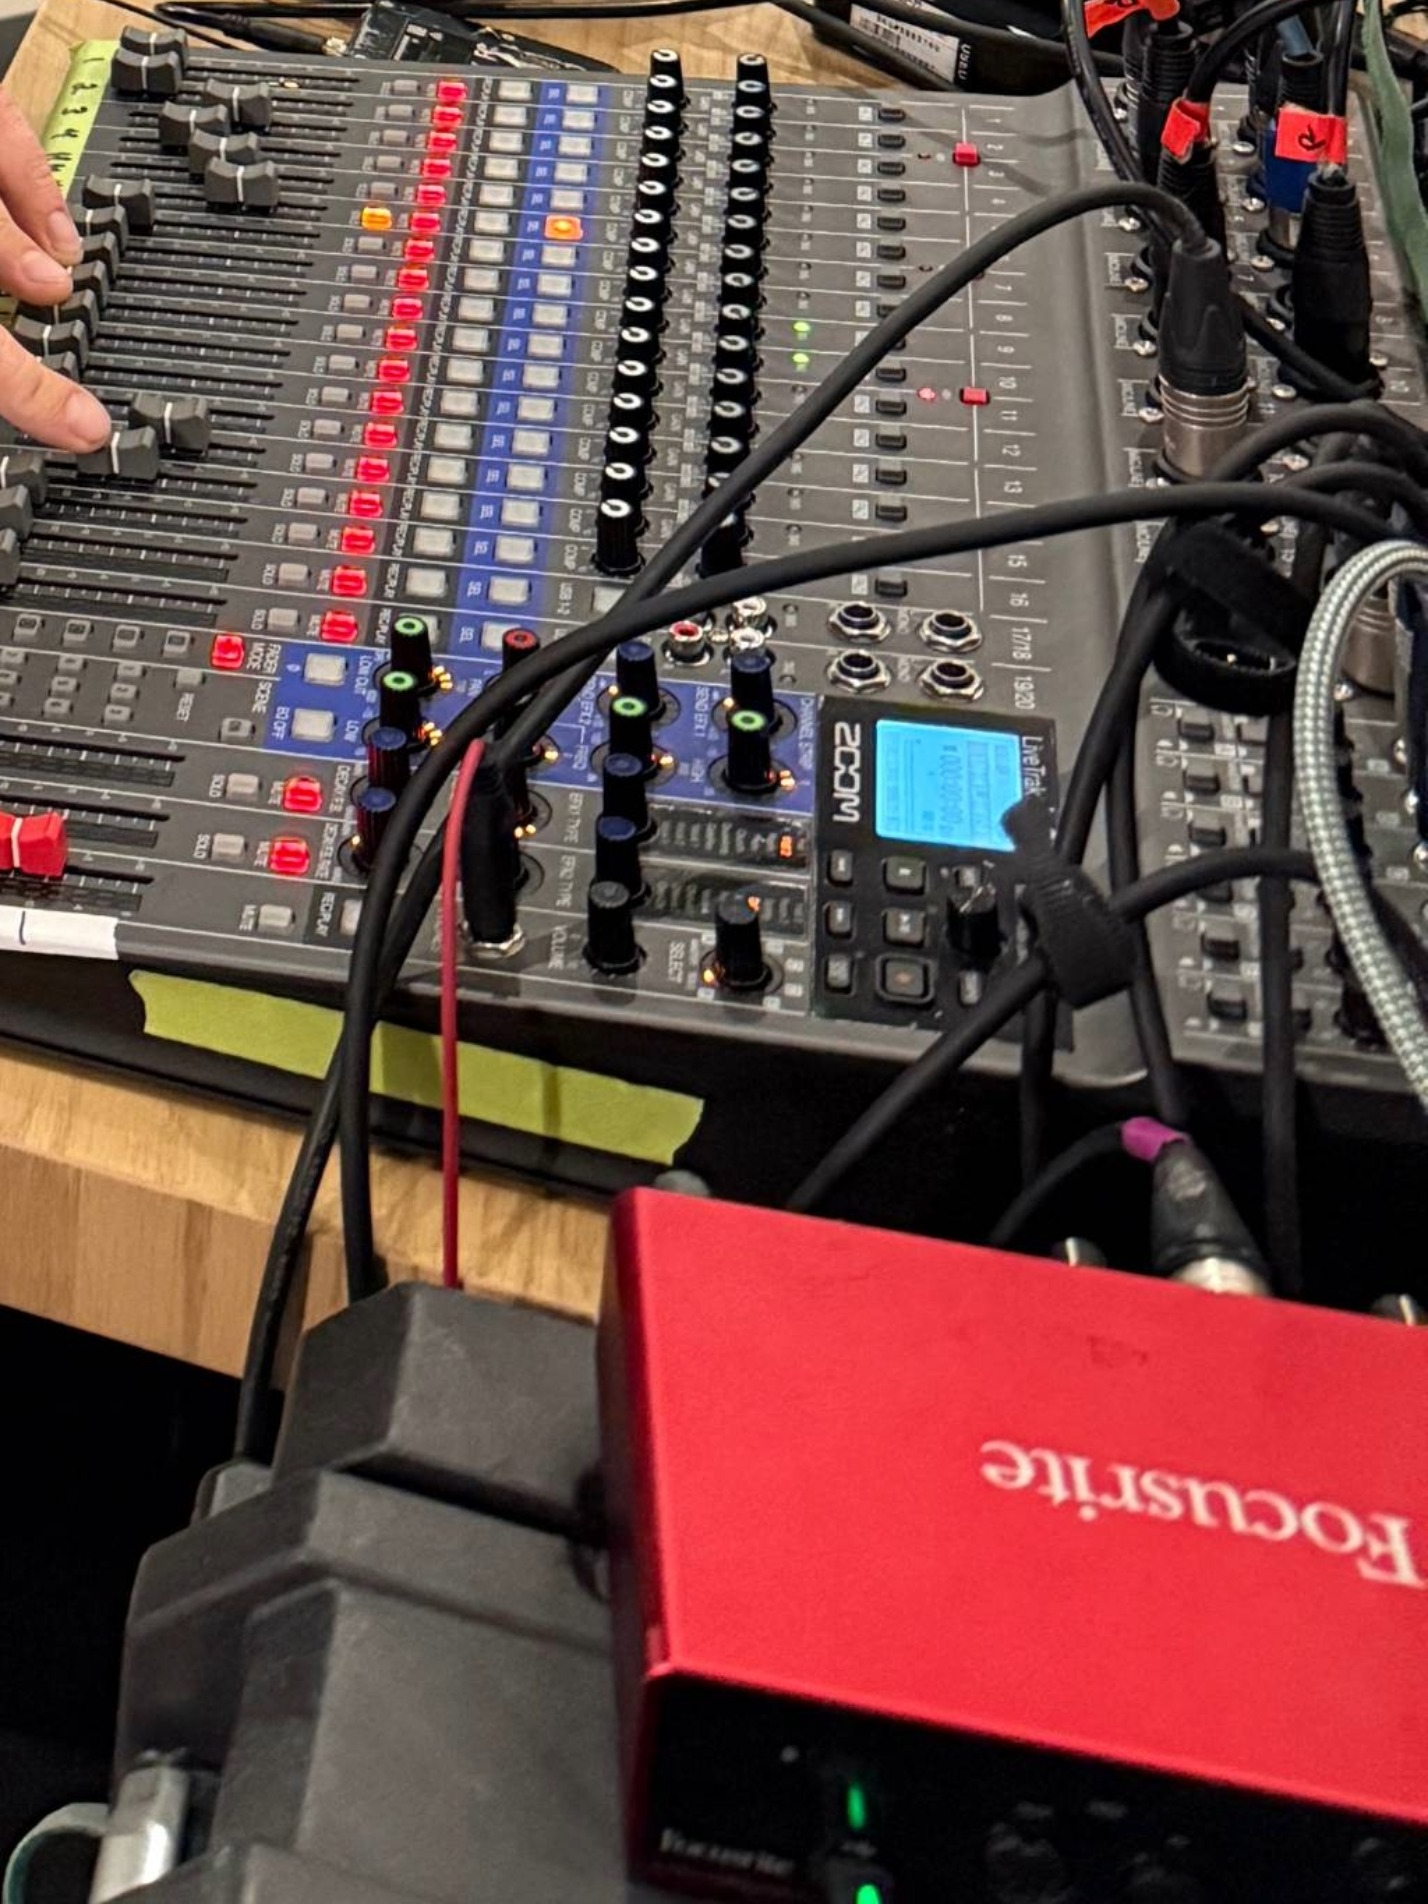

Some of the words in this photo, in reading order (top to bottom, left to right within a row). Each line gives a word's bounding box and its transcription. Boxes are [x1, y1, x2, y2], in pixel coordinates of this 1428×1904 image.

[999, 376, 1017, 389] 10
[1001, 410, 1018, 421] 11
[1002, 444, 1021, 456] 12
[1003, 481, 1022, 493] 13
[272, 524, 286, 543] SOLO
[1008, 555, 1027, 567] 15
[262, 563, 276, 584] SOLO
[467, 582, 481, 597] SEL
[559, 583, 573, 601] USB
[1010, 593, 1029, 606] 16
[251, 609, 265, 630] SOLO
[557, 602, 570, 615] 1-2
[460, 628, 474, 642] SEL
[1011, 627, 1032, 659] 17/18
[248, 643, 265, 669] MODE
[262, 643, 279, 673] FADER
[252, 682, 271, 713] SCENE
[1015, 676, 1035, 709] 19/20
[177, 693, 193, 721] RESET
[798, 698, 812, 738] CHANNEL
[272, 721, 285, 739] OFF
[345, 720, 359, 740] LOW
[573, 744, 586, 770] FREQ
[1021, 736, 1045, 795] LiveTrak
[832, 722, 862, 822] ZOOM
[210, 774, 224, 797] SOLO
[565, 818, 579, 843] TYPE
[195, 834, 210, 858] SOLO
[556, 880, 571, 906] TYPE
[241, 905, 255, 930] MUTE
[550, 925, 566, 969] VOLUME
[669, 942, 683, 983] SELECT
[980, 1440, 1428, 1588] Focusrite
